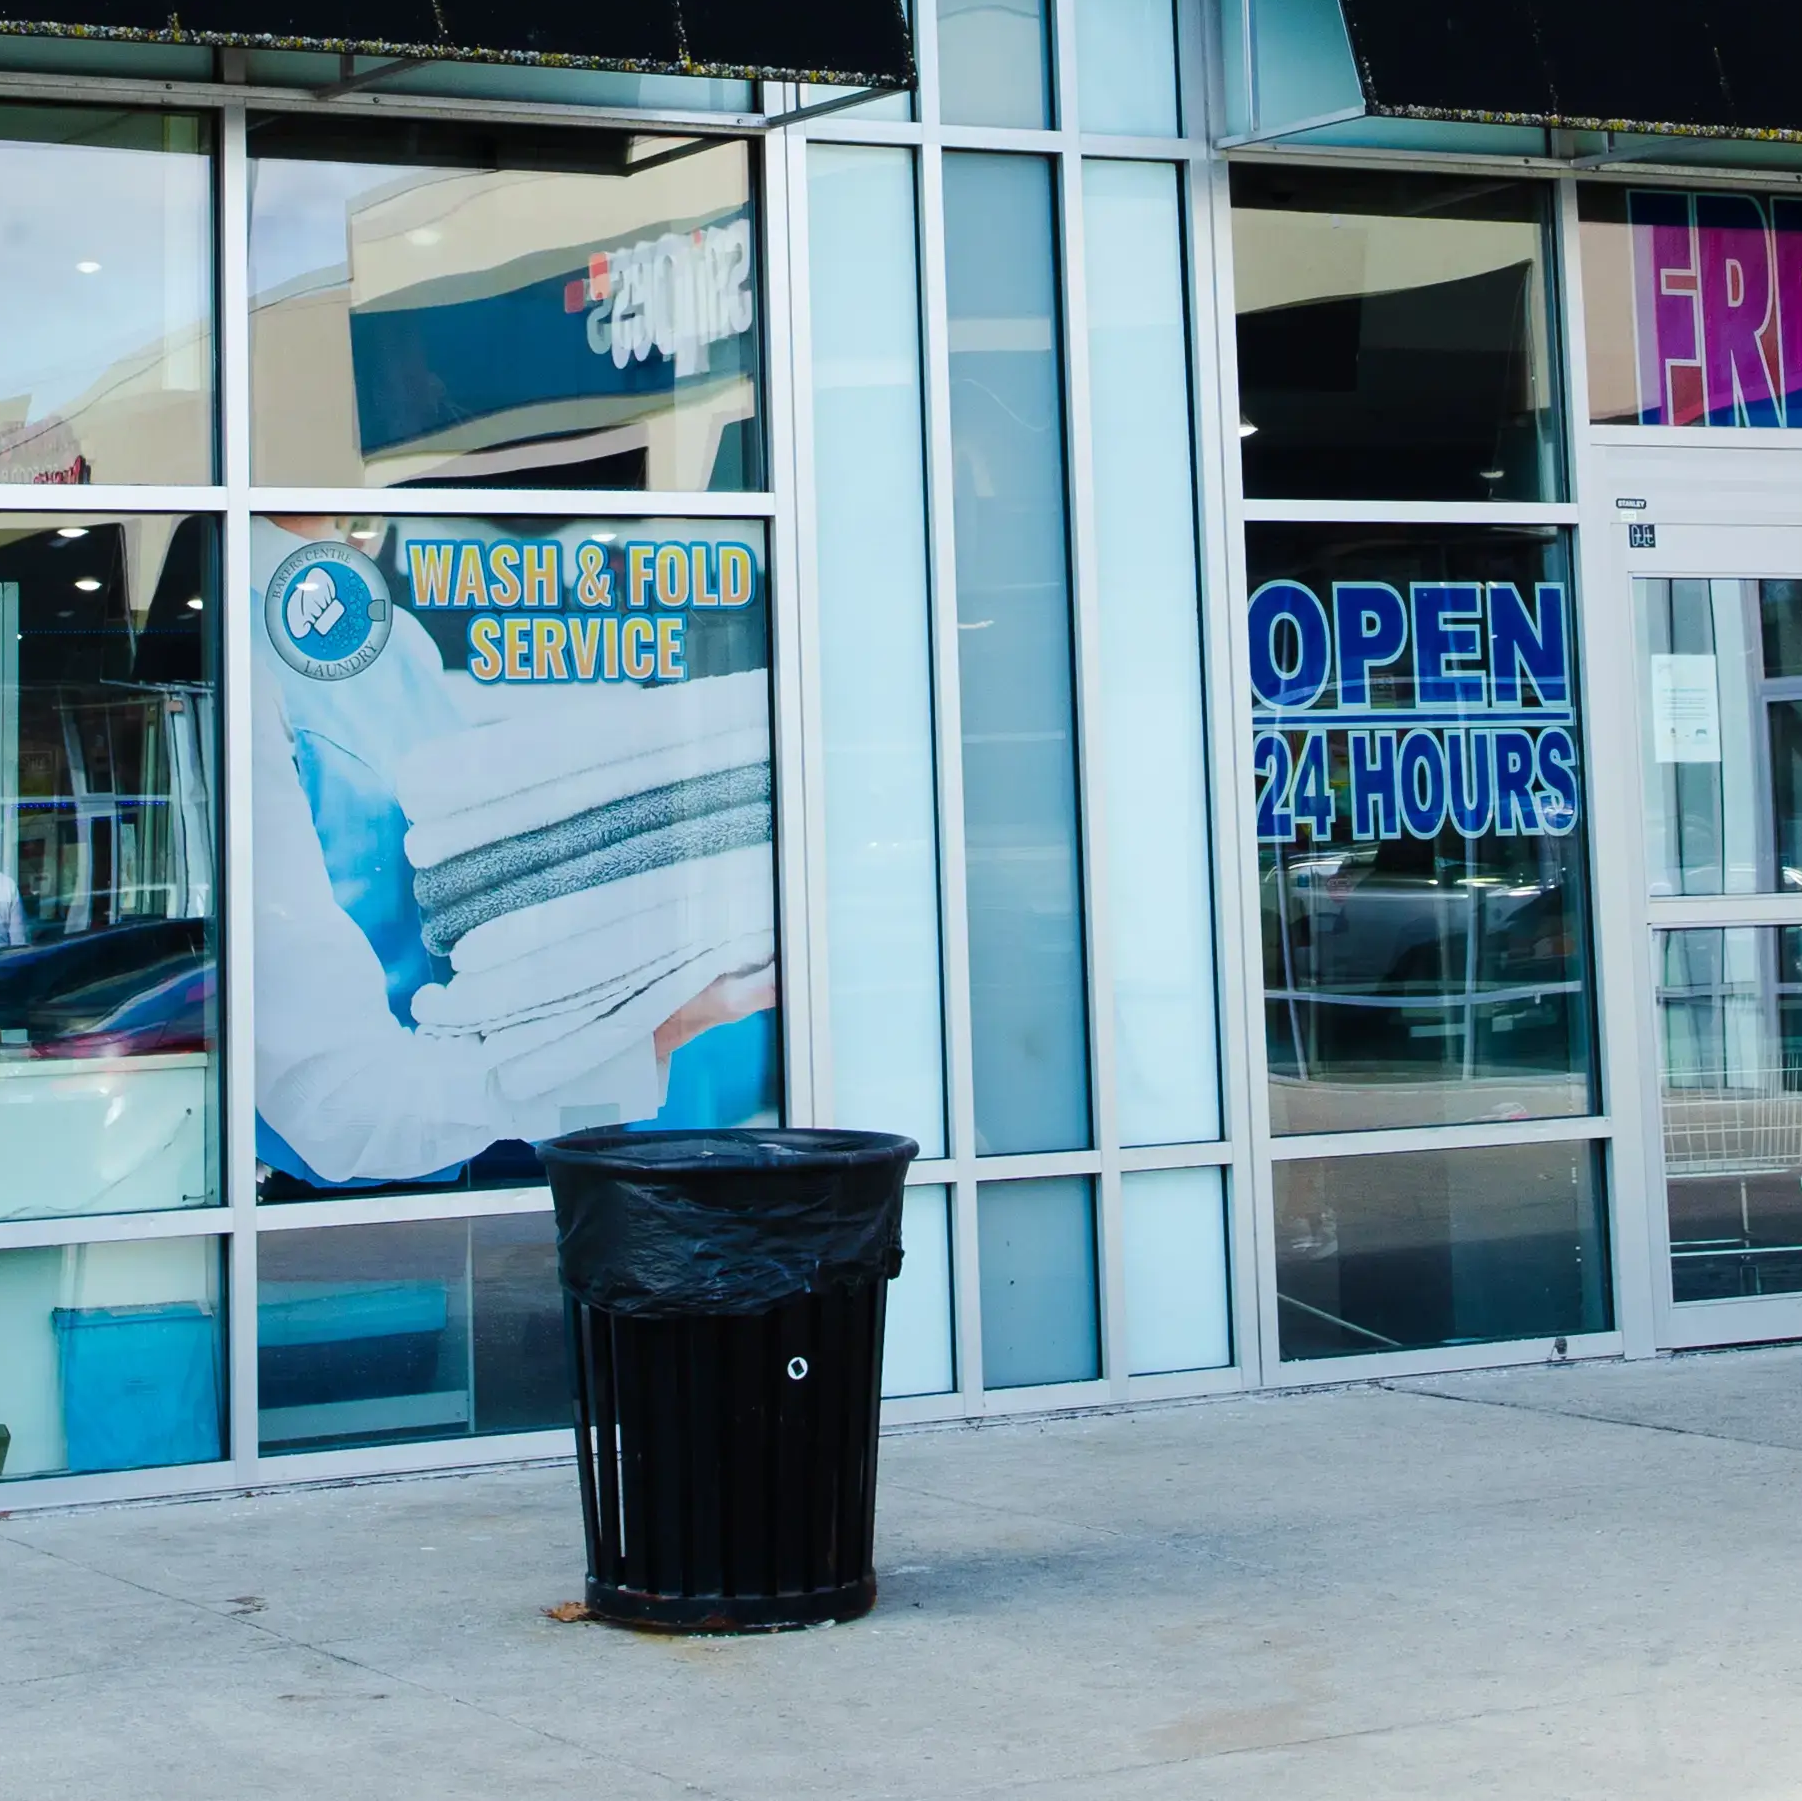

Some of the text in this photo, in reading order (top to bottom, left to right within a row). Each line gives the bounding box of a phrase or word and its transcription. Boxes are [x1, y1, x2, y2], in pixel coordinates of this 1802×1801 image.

[272, 548, 351, 599] BAKERS CENTRE
[408, 544, 753, 608] WASH & FOLD
[304, 640, 377, 678] LAUNDRY
[470, 617, 685, 681] SERVICE
[1248, 579, 1572, 710] OPEN
[1252, 726, 1579, 843] 24 HOURS
